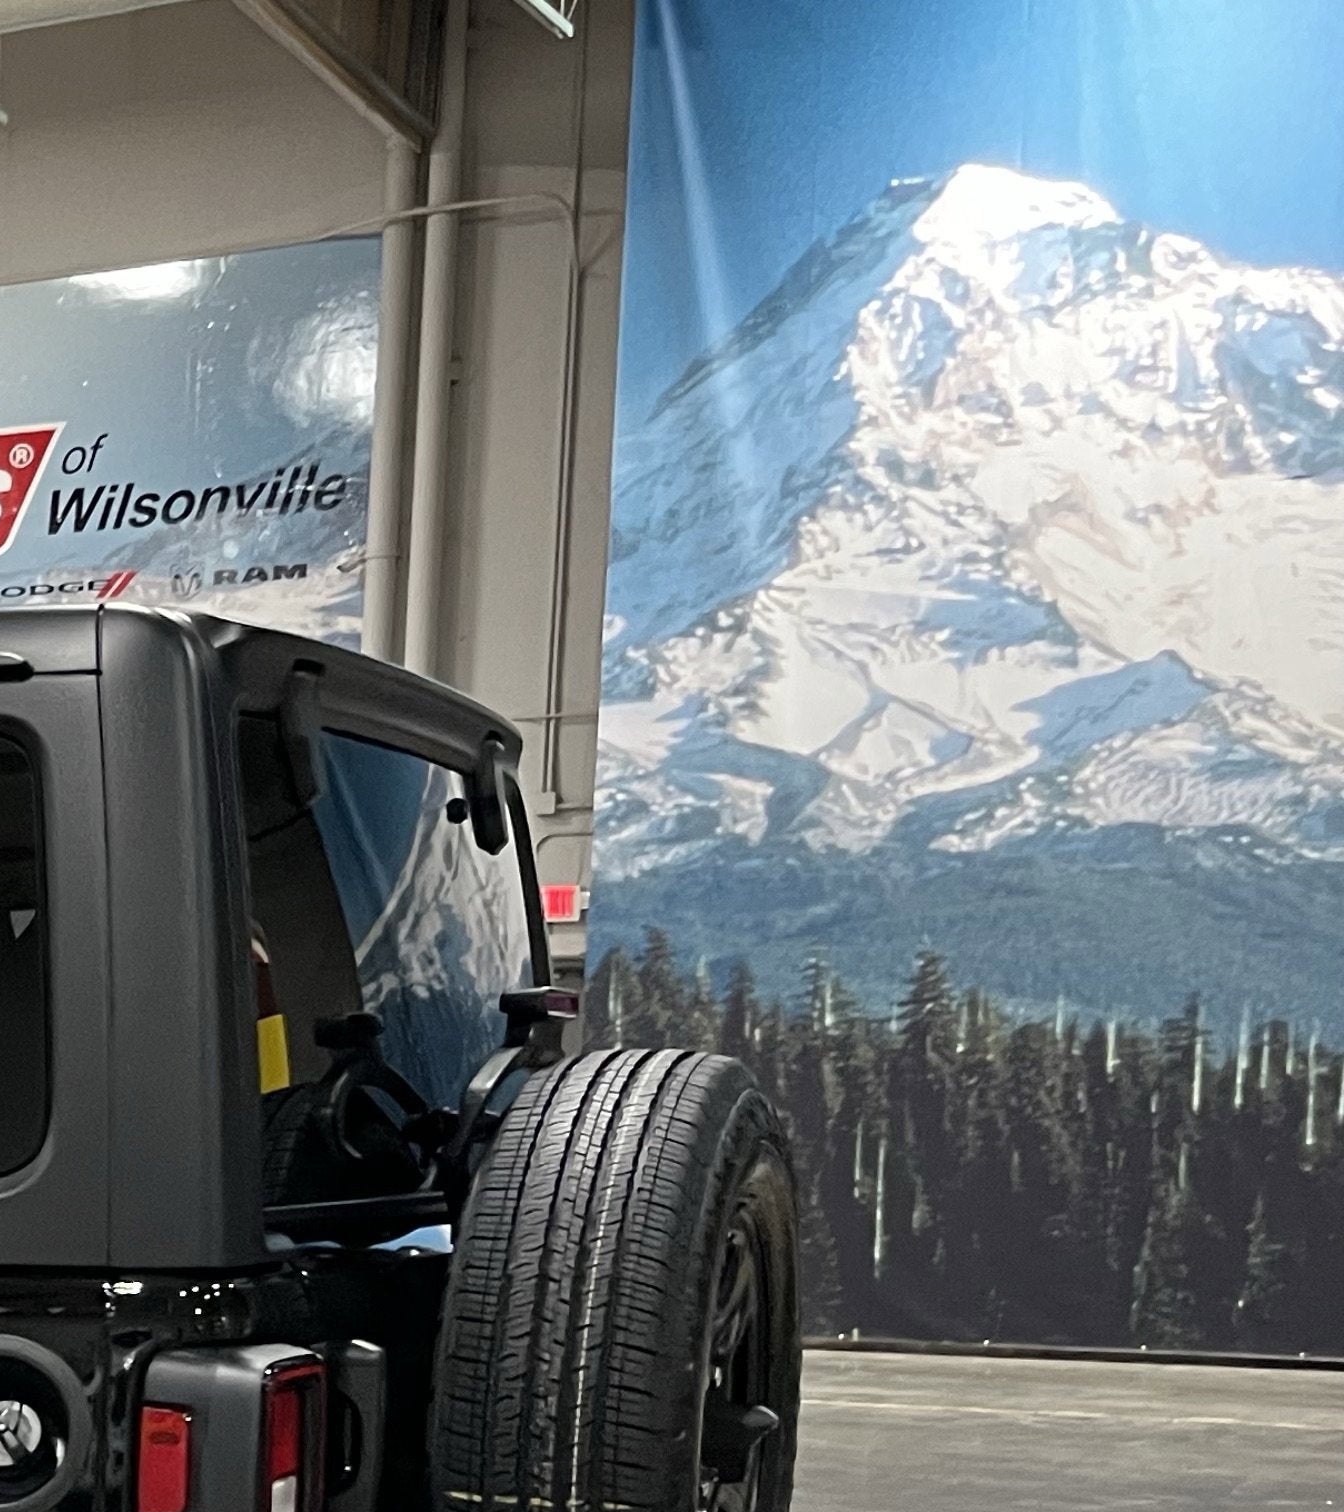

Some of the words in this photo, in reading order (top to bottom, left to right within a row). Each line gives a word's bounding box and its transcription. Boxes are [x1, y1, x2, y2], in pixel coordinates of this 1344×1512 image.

[62, 433, 108, 475] of
[47, 462, 347, 536] Wilsonville
[214, 562, 308, 587] RAM
